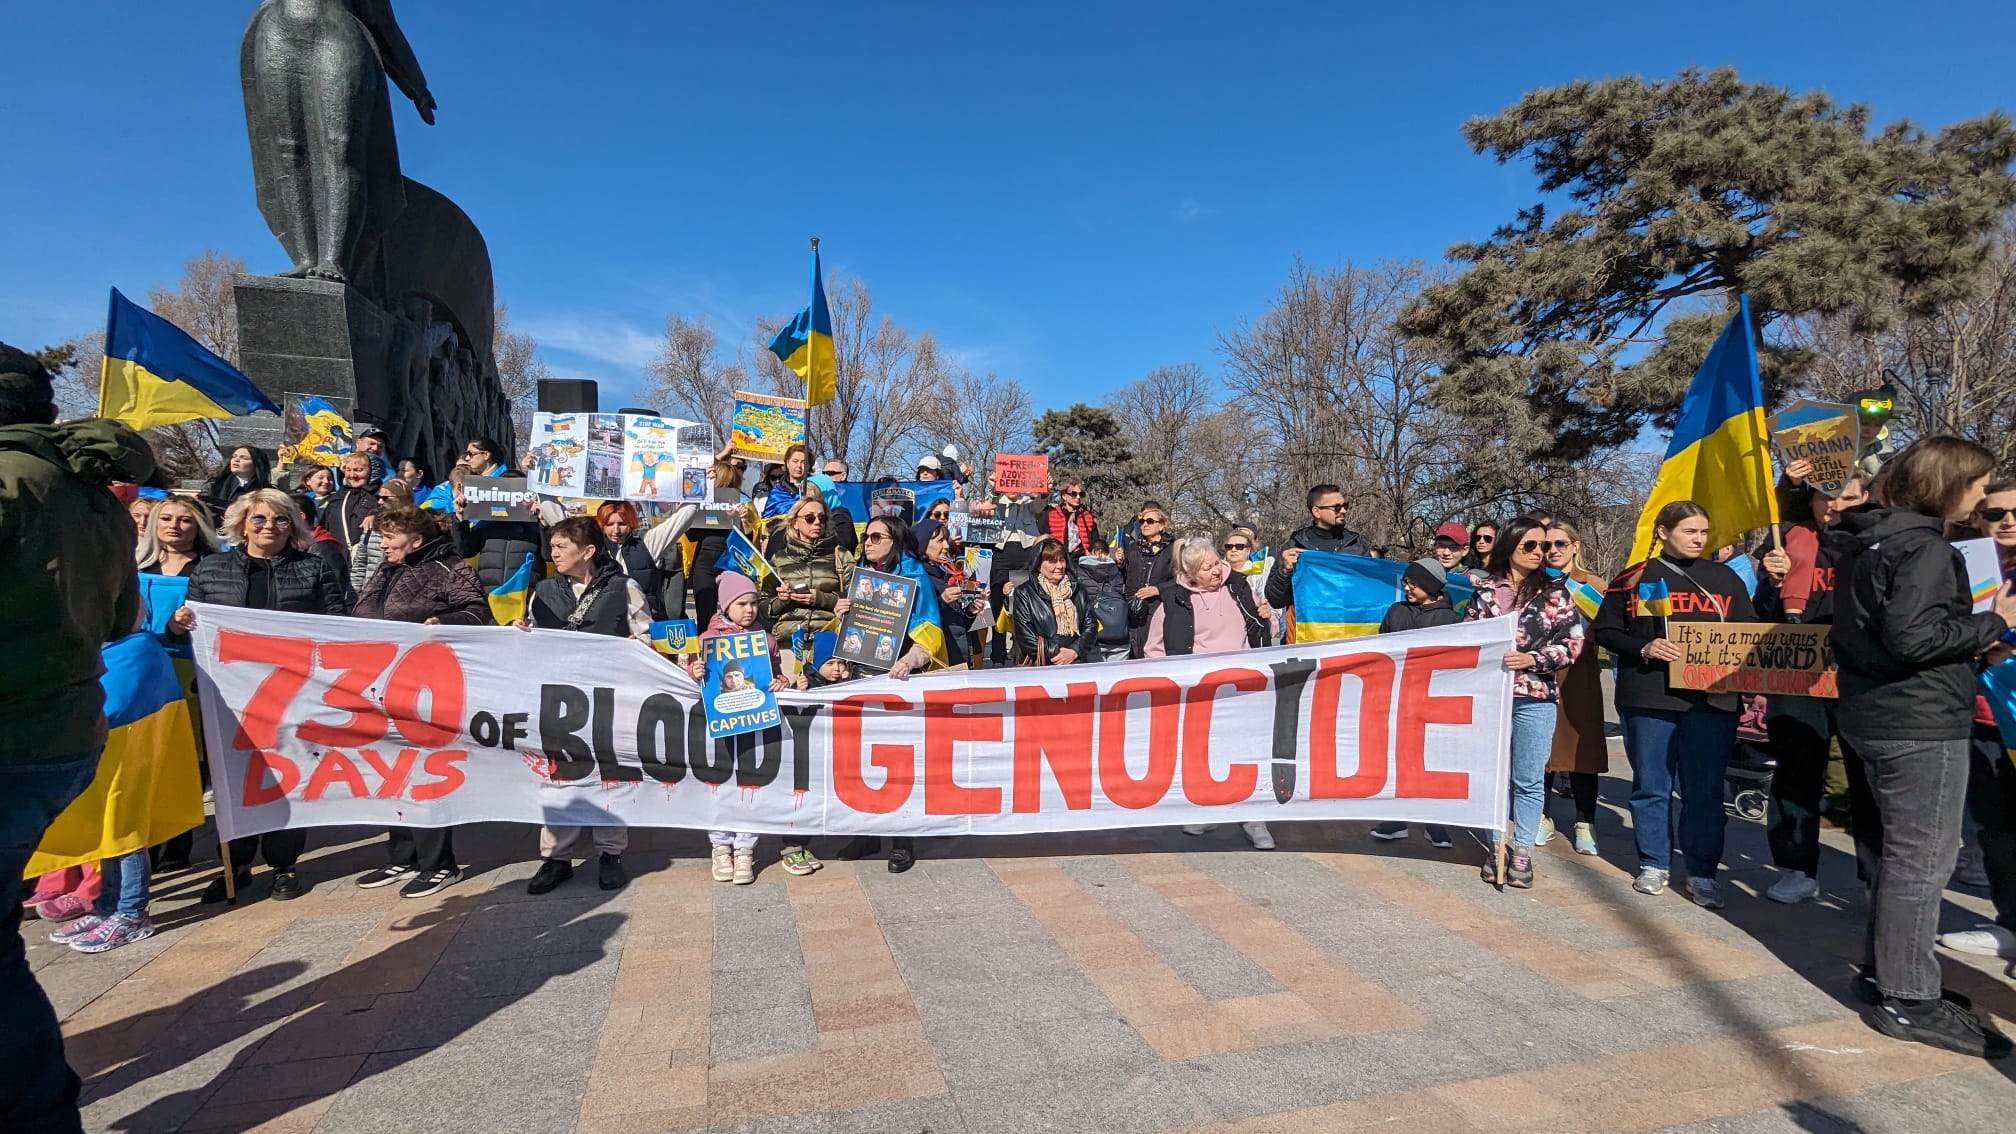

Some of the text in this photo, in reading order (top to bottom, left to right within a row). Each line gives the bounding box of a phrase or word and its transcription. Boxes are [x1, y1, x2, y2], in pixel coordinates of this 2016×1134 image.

[1786, 435, 1853, 460] UCRAINA
[1807, 470, 1847, 483] EUROPEI
[1814, 460, 1847, 472] UTUL
[463, 486, 536, 507] Дніпро
[697, 502, 740, 512] ганськ
[703, 633, 767, 662] FREE
[1678, 625, 1702, 644] It's
[1709, 629, 1724, 645] in
[1728, 632, 1738, 645] a
[1686, 644, 1711, 665] but
[1719, 644, 1741, 666] it's
[1746, 652, 1756, 667] a
[1756, 646, 1818, 670] WORLD
[213, 626, 466, 749] 730
[470, 711, 529, 750] OF
[709, 708, 778, 733] CAPTIVES
[242, 747, 468, 807] DAYS
